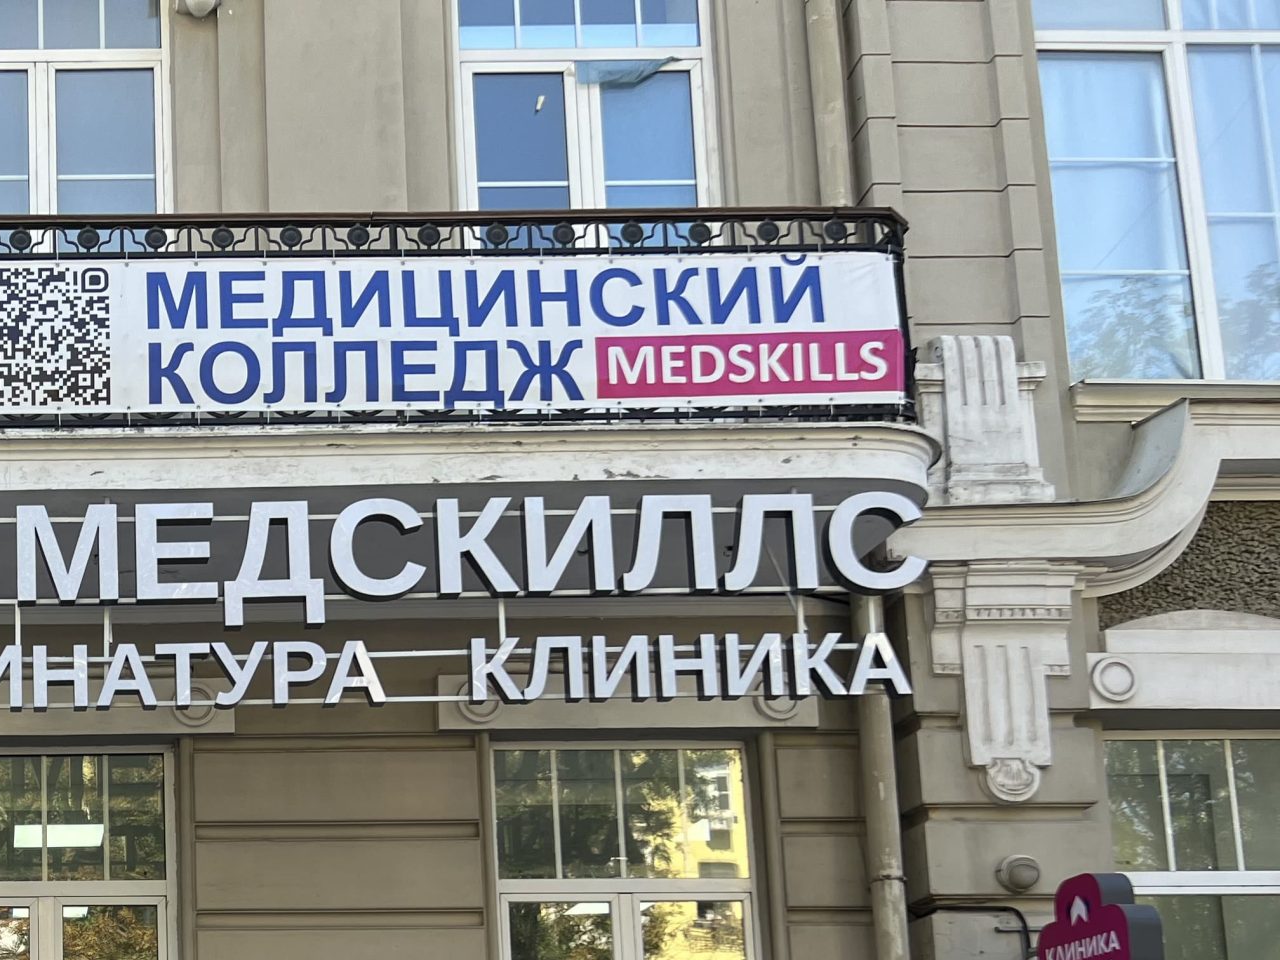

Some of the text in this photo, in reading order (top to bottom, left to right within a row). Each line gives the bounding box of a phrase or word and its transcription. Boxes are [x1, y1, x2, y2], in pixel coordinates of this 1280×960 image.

[146, 255, 825, 336] МЕДИЦИНСКИЙ
[148, 339, 586, 410] КОЛЛЕДЖ
[607, 341, 888, 385] MEDSKILLS
[16, 491, 928, 627] МЕДСКИЛЛС
[469, 632, 913, 703] КЛИНИКА
